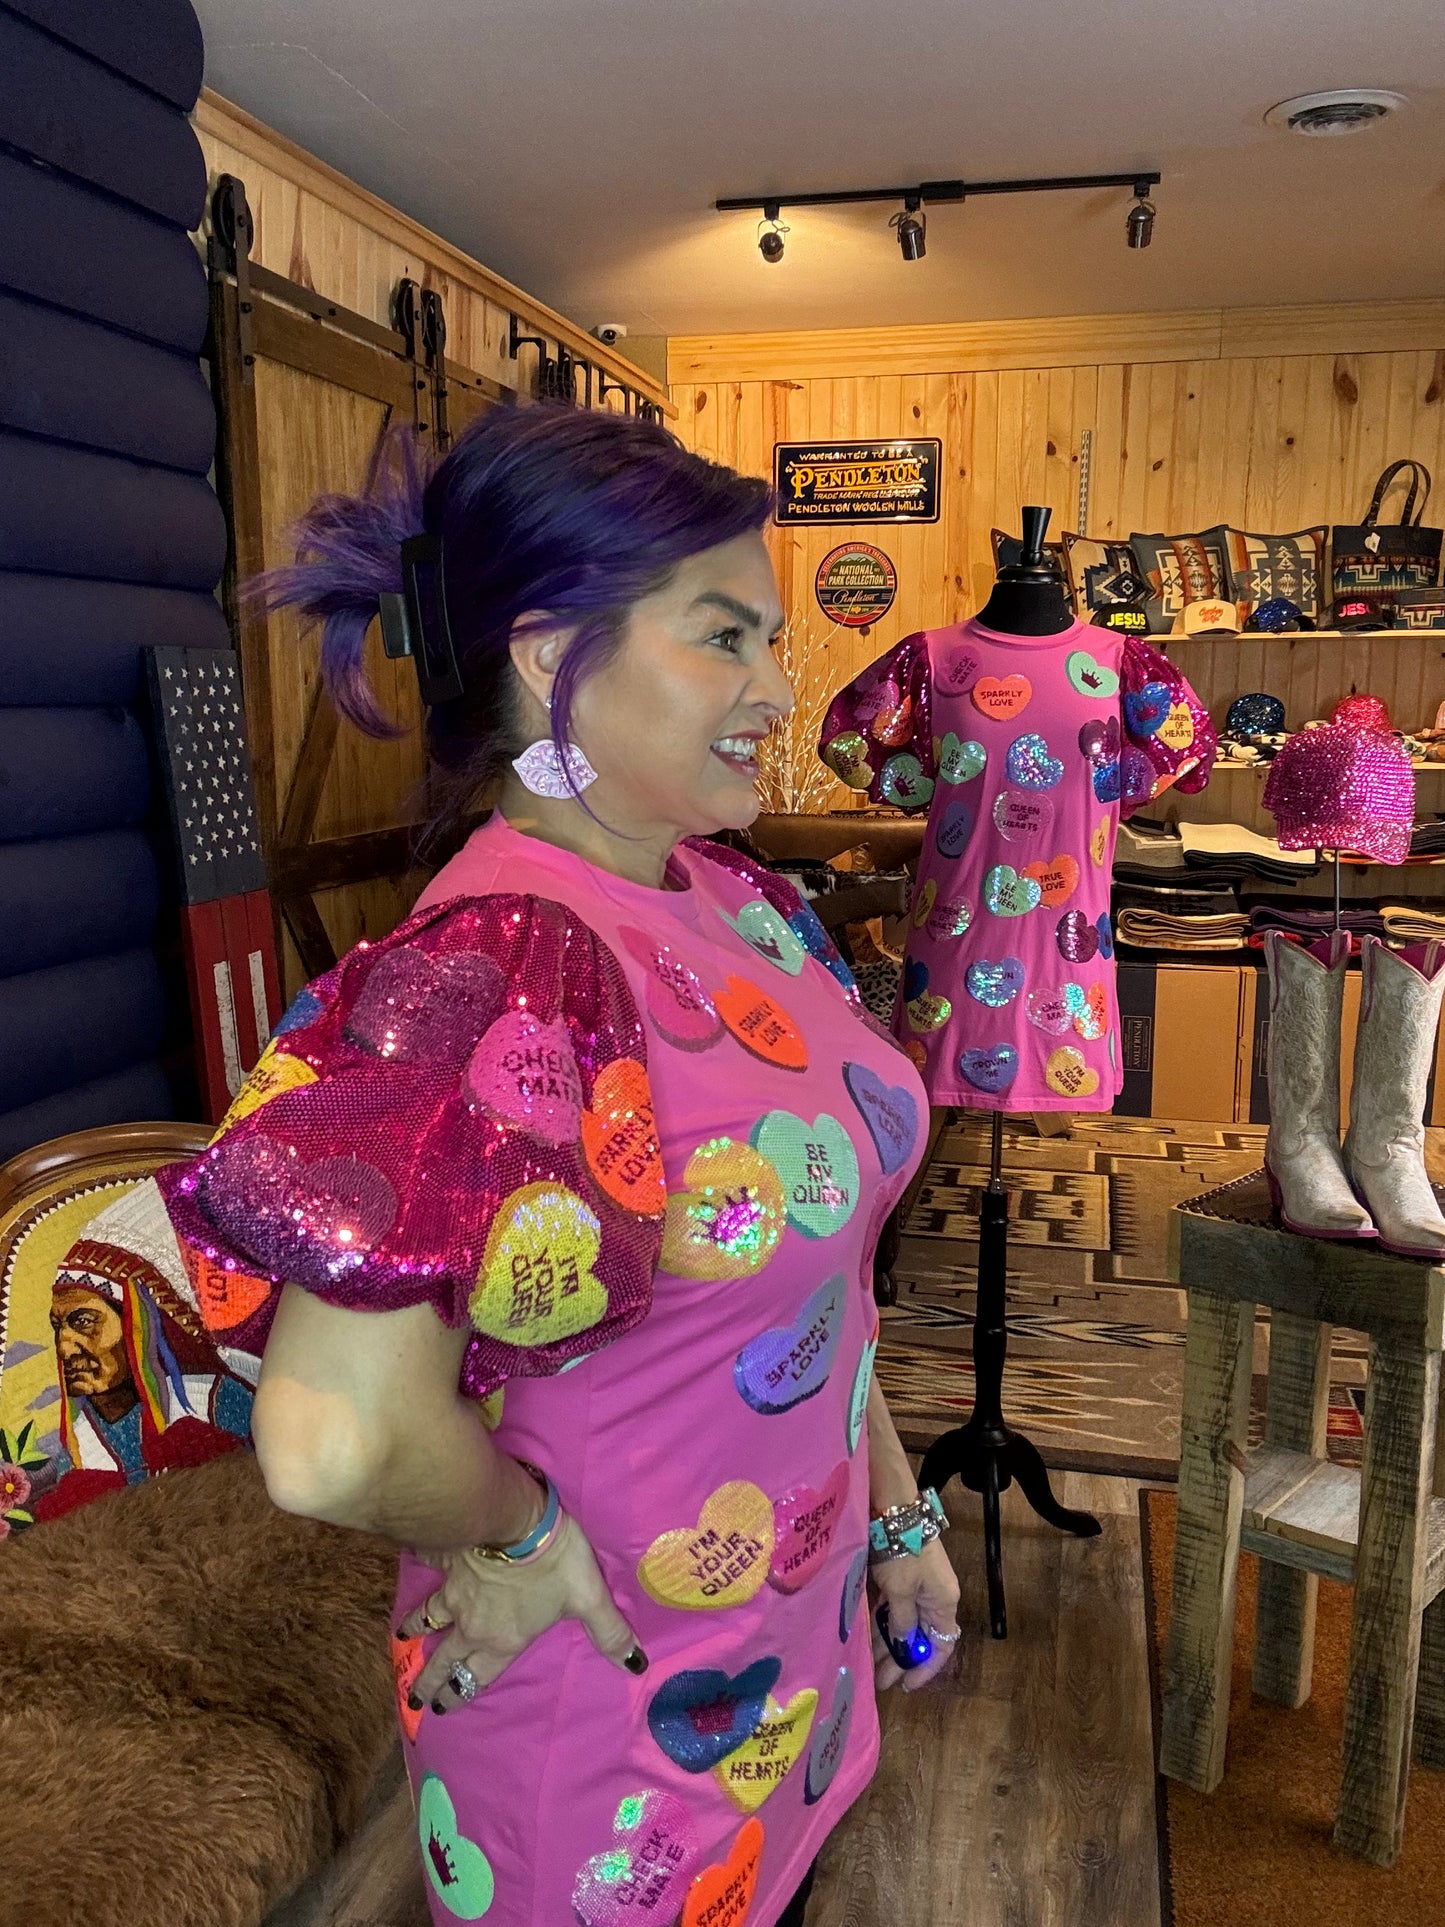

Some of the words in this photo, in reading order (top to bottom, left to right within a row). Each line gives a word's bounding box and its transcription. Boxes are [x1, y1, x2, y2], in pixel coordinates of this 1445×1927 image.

[799, 451, 868, 461] WARRANTED
[872, 449, 885, 458] TO
[888, 447, 902, 458] BE
[907, 446, 914, 457] A
[813, 492, 838, 500] TRADE
[788, 503, 851, 514] PENDLETON
[852, 501, 895, 513] WOOLEN
[897, 500, 925, 511] MILLS
[838, 564, 874, 575] NATIONAL
[828, 575, 845, 586] PARK
[845, 575, 885, 586] COLLECTION
[1338, 602, 1370, 618] JES
[1106, 613, 1146, 627] JESUS
[949, 655, 972, 683] CHECK
[956, 661, 978, 685] MATE
[980, 690, 1024, 700] SPARKLY
[989, 699, 1014, 707] LOVE
[1175, 721, 1184, 729] OF
[1009, 803, 1041, 816] QUEEN
[1017, 813, 1029, 822] OF
[1038, 872, 1064, 884] TRUE
[1041, 881, 1066, 893] LOVE
[999, 889, 1014, 901] MY
[1005, 883, 1017, 894] BE
[1133, 1020, 1143, 1065] PENDLETON
[972, 1057, 1008, 1070] CROWN
[1073, 1065, 1085, 1078] I'M
[1054, 1070, 1078, 1094] QUEEN
[1063, 1066, 1082, 1087] YOUR
[805, 1143, 829, 1162] BE
[805, 1163, 832, 1183] MY
[507, 1253, 534, 1329] QUEEN
[764, 1297, 837, 1389] SPARKLY
[791, 1330, 830, 1382] LOVE
[793, 1496, 837, 1534] QUEEN
[805, 1523, 822, 1544] OF
[688, 1528, 721, 1559] I'M
[783, 1527, 831, 1574] HEARTS
[691, 1532, 747, 1583] YOUR
[701, 1539, 763, 1597] QUEEN
[759, 1738, 778, 1757] OF
[729, 1756, 790, 1781] HEARTS
[614, 1828, 669, 1906] CHECK
[638, 1842, 686, 1910] MATE
[696, 1855, 757, 1927] SPARKLY
[715, 1889, 746, 1927] OVE
